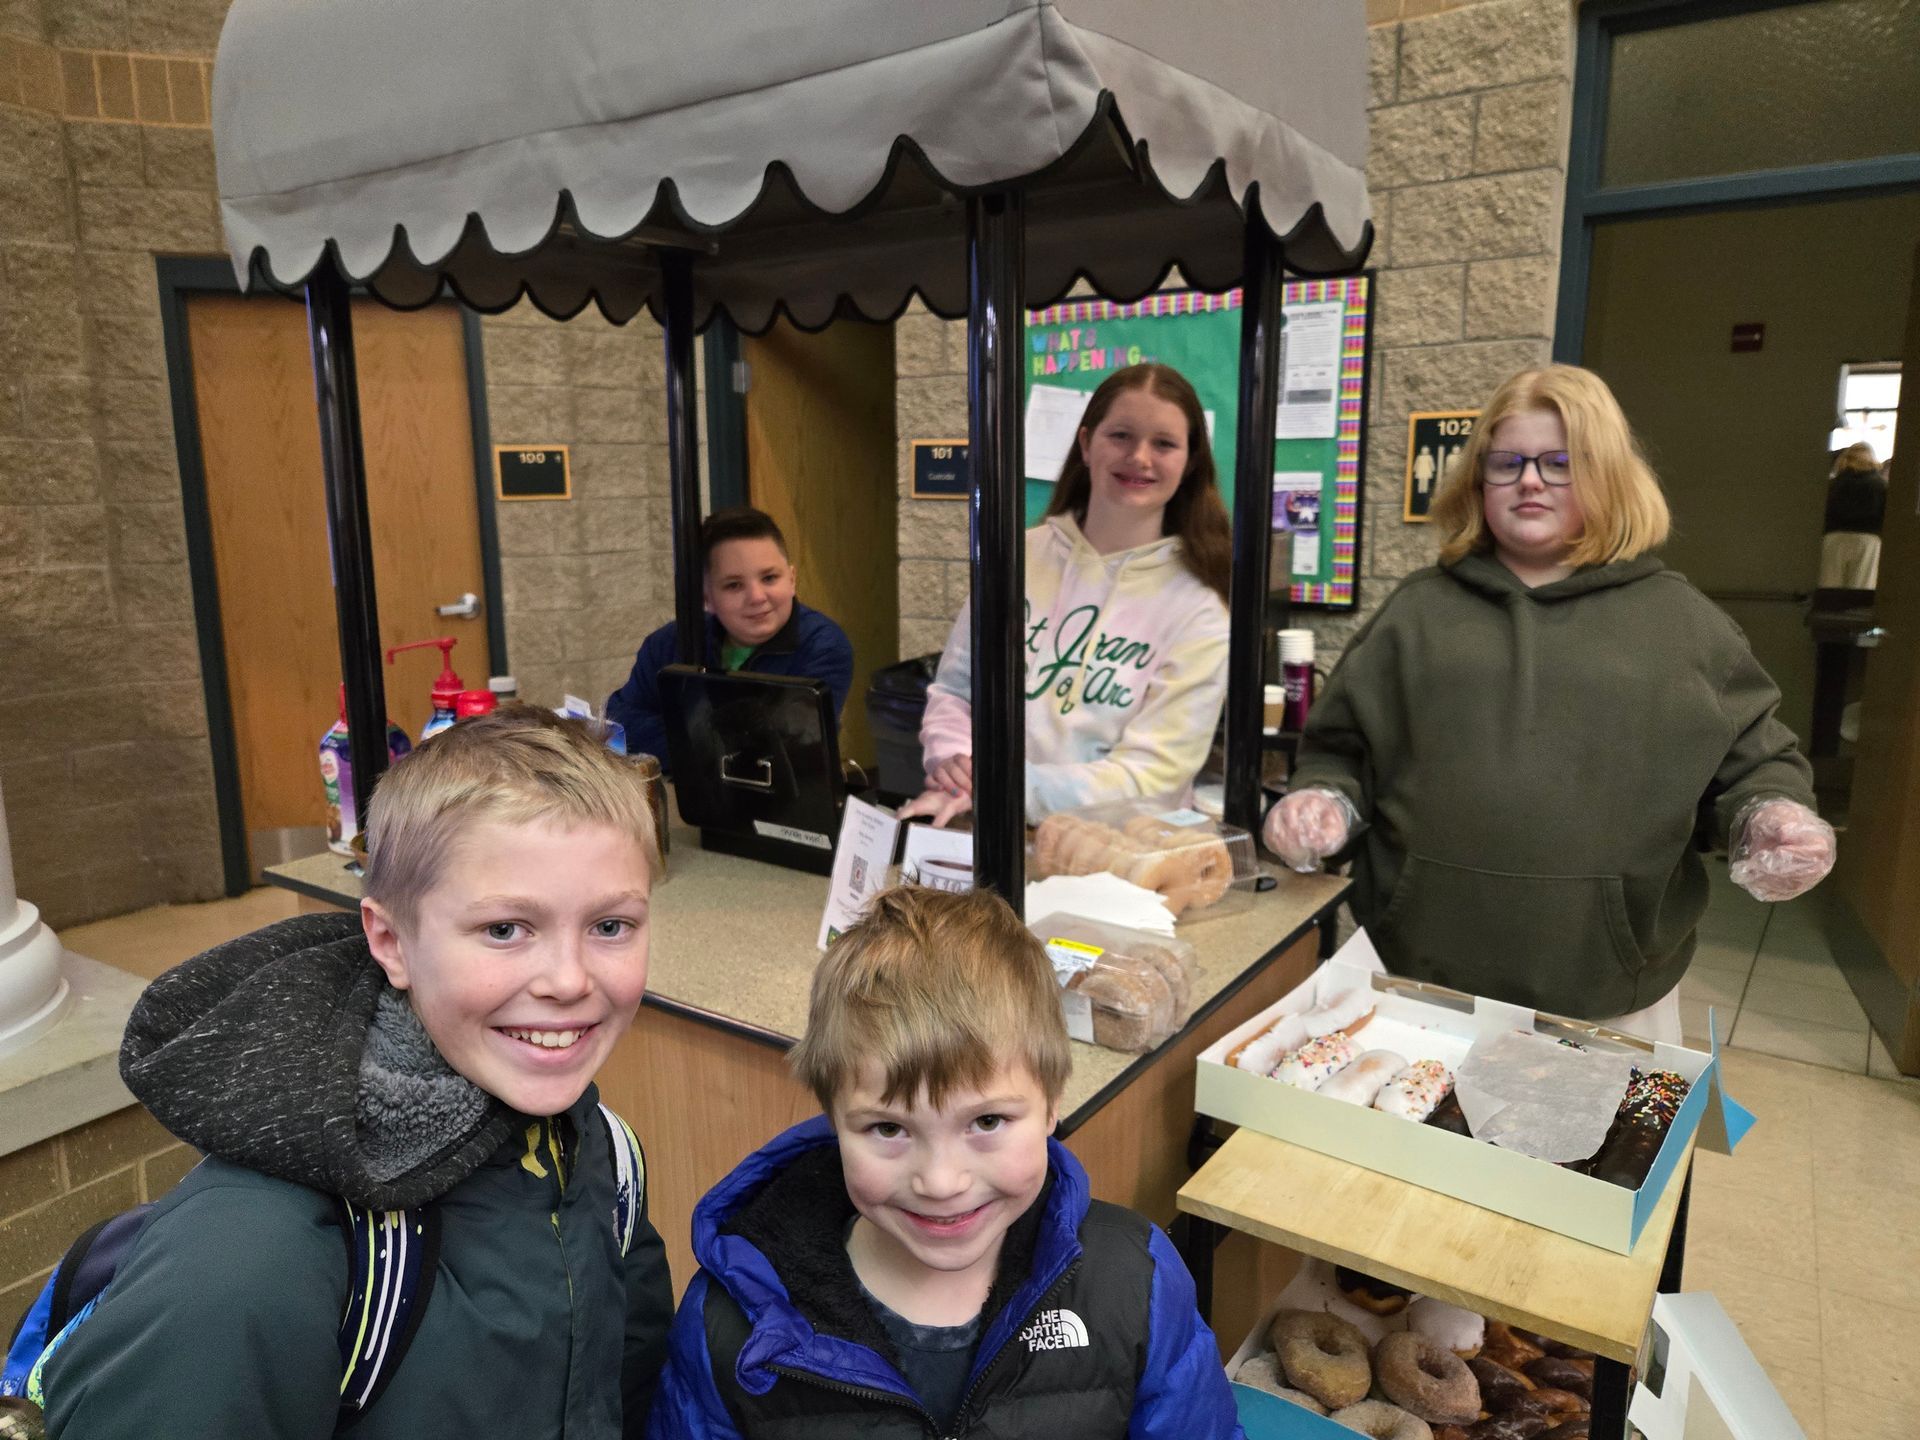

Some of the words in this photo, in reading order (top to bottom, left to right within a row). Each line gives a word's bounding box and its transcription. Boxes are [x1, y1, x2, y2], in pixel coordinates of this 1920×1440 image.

[1438, 419, 1473, 436] 102
[520, 452, 546, 464] 100
[932, 447, 953, 460] 101
[1018, 1321, 1062, 1342] ORTH
[1028, 1334, 1065, 1352] FACE
